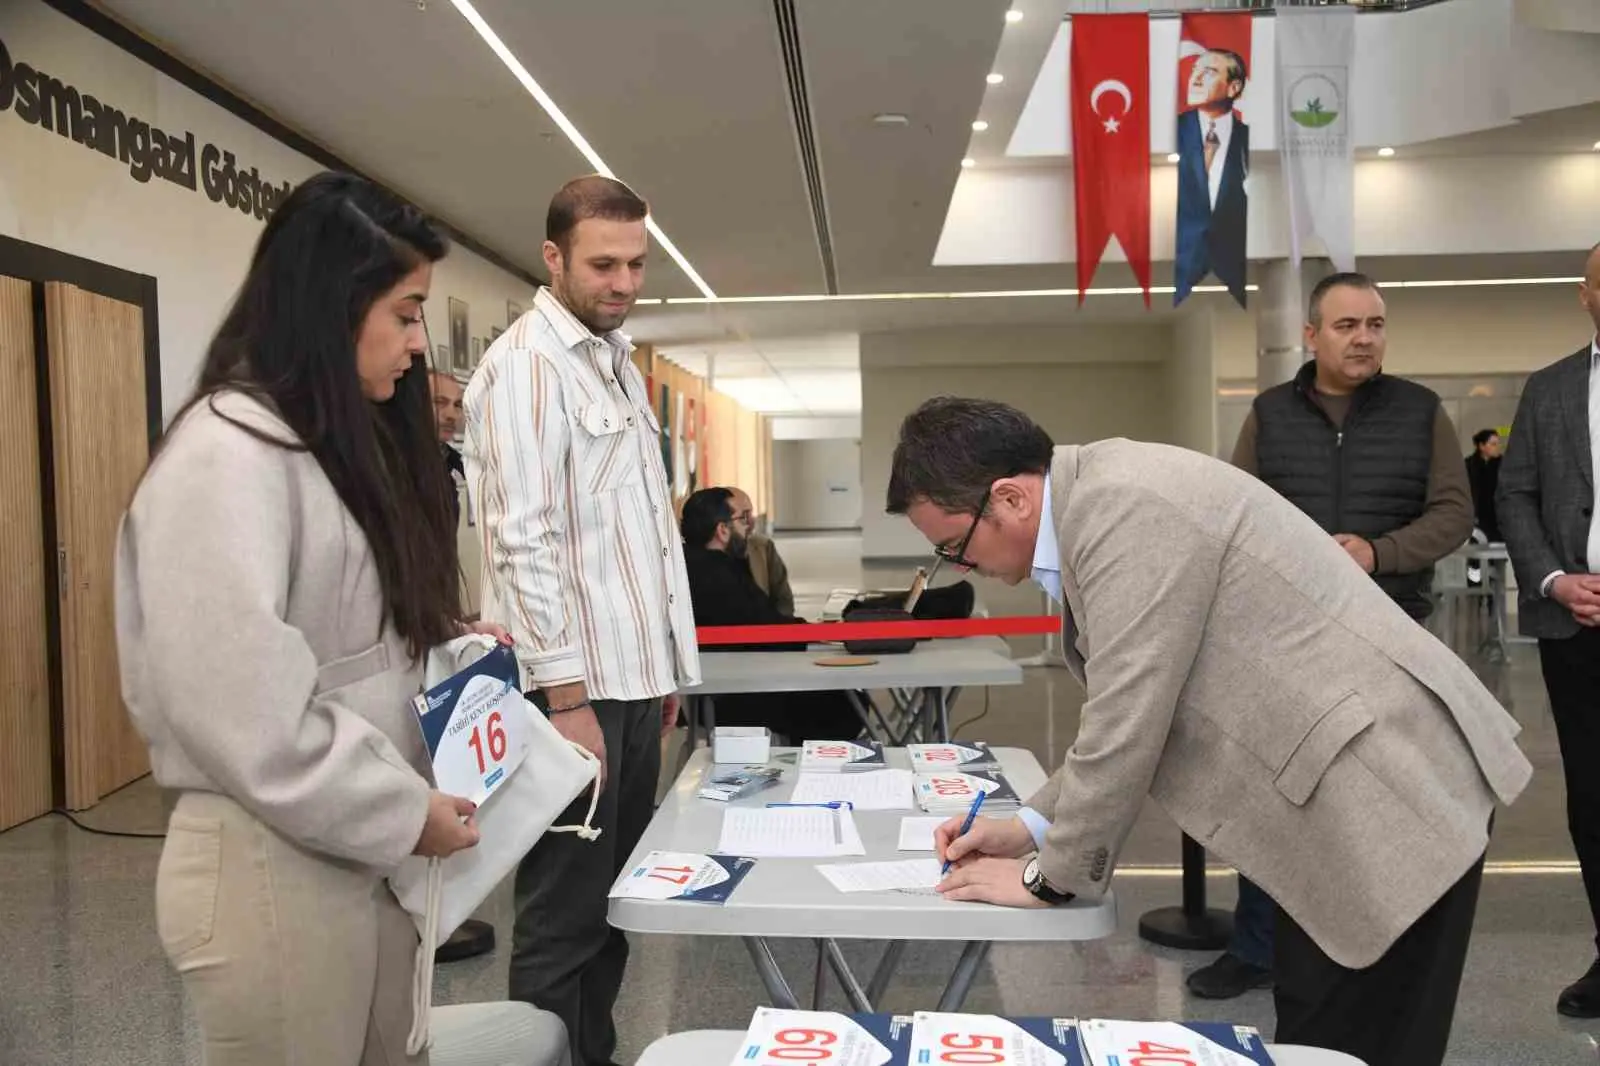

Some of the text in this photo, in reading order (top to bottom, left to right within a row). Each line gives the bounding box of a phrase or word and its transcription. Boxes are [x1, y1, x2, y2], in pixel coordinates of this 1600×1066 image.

[468, 710, 506, 775] 16
[931, 777, 974, 796] 203
[647, 865, 696, 886] 17
[763, 1028, 838, 1066] 60
